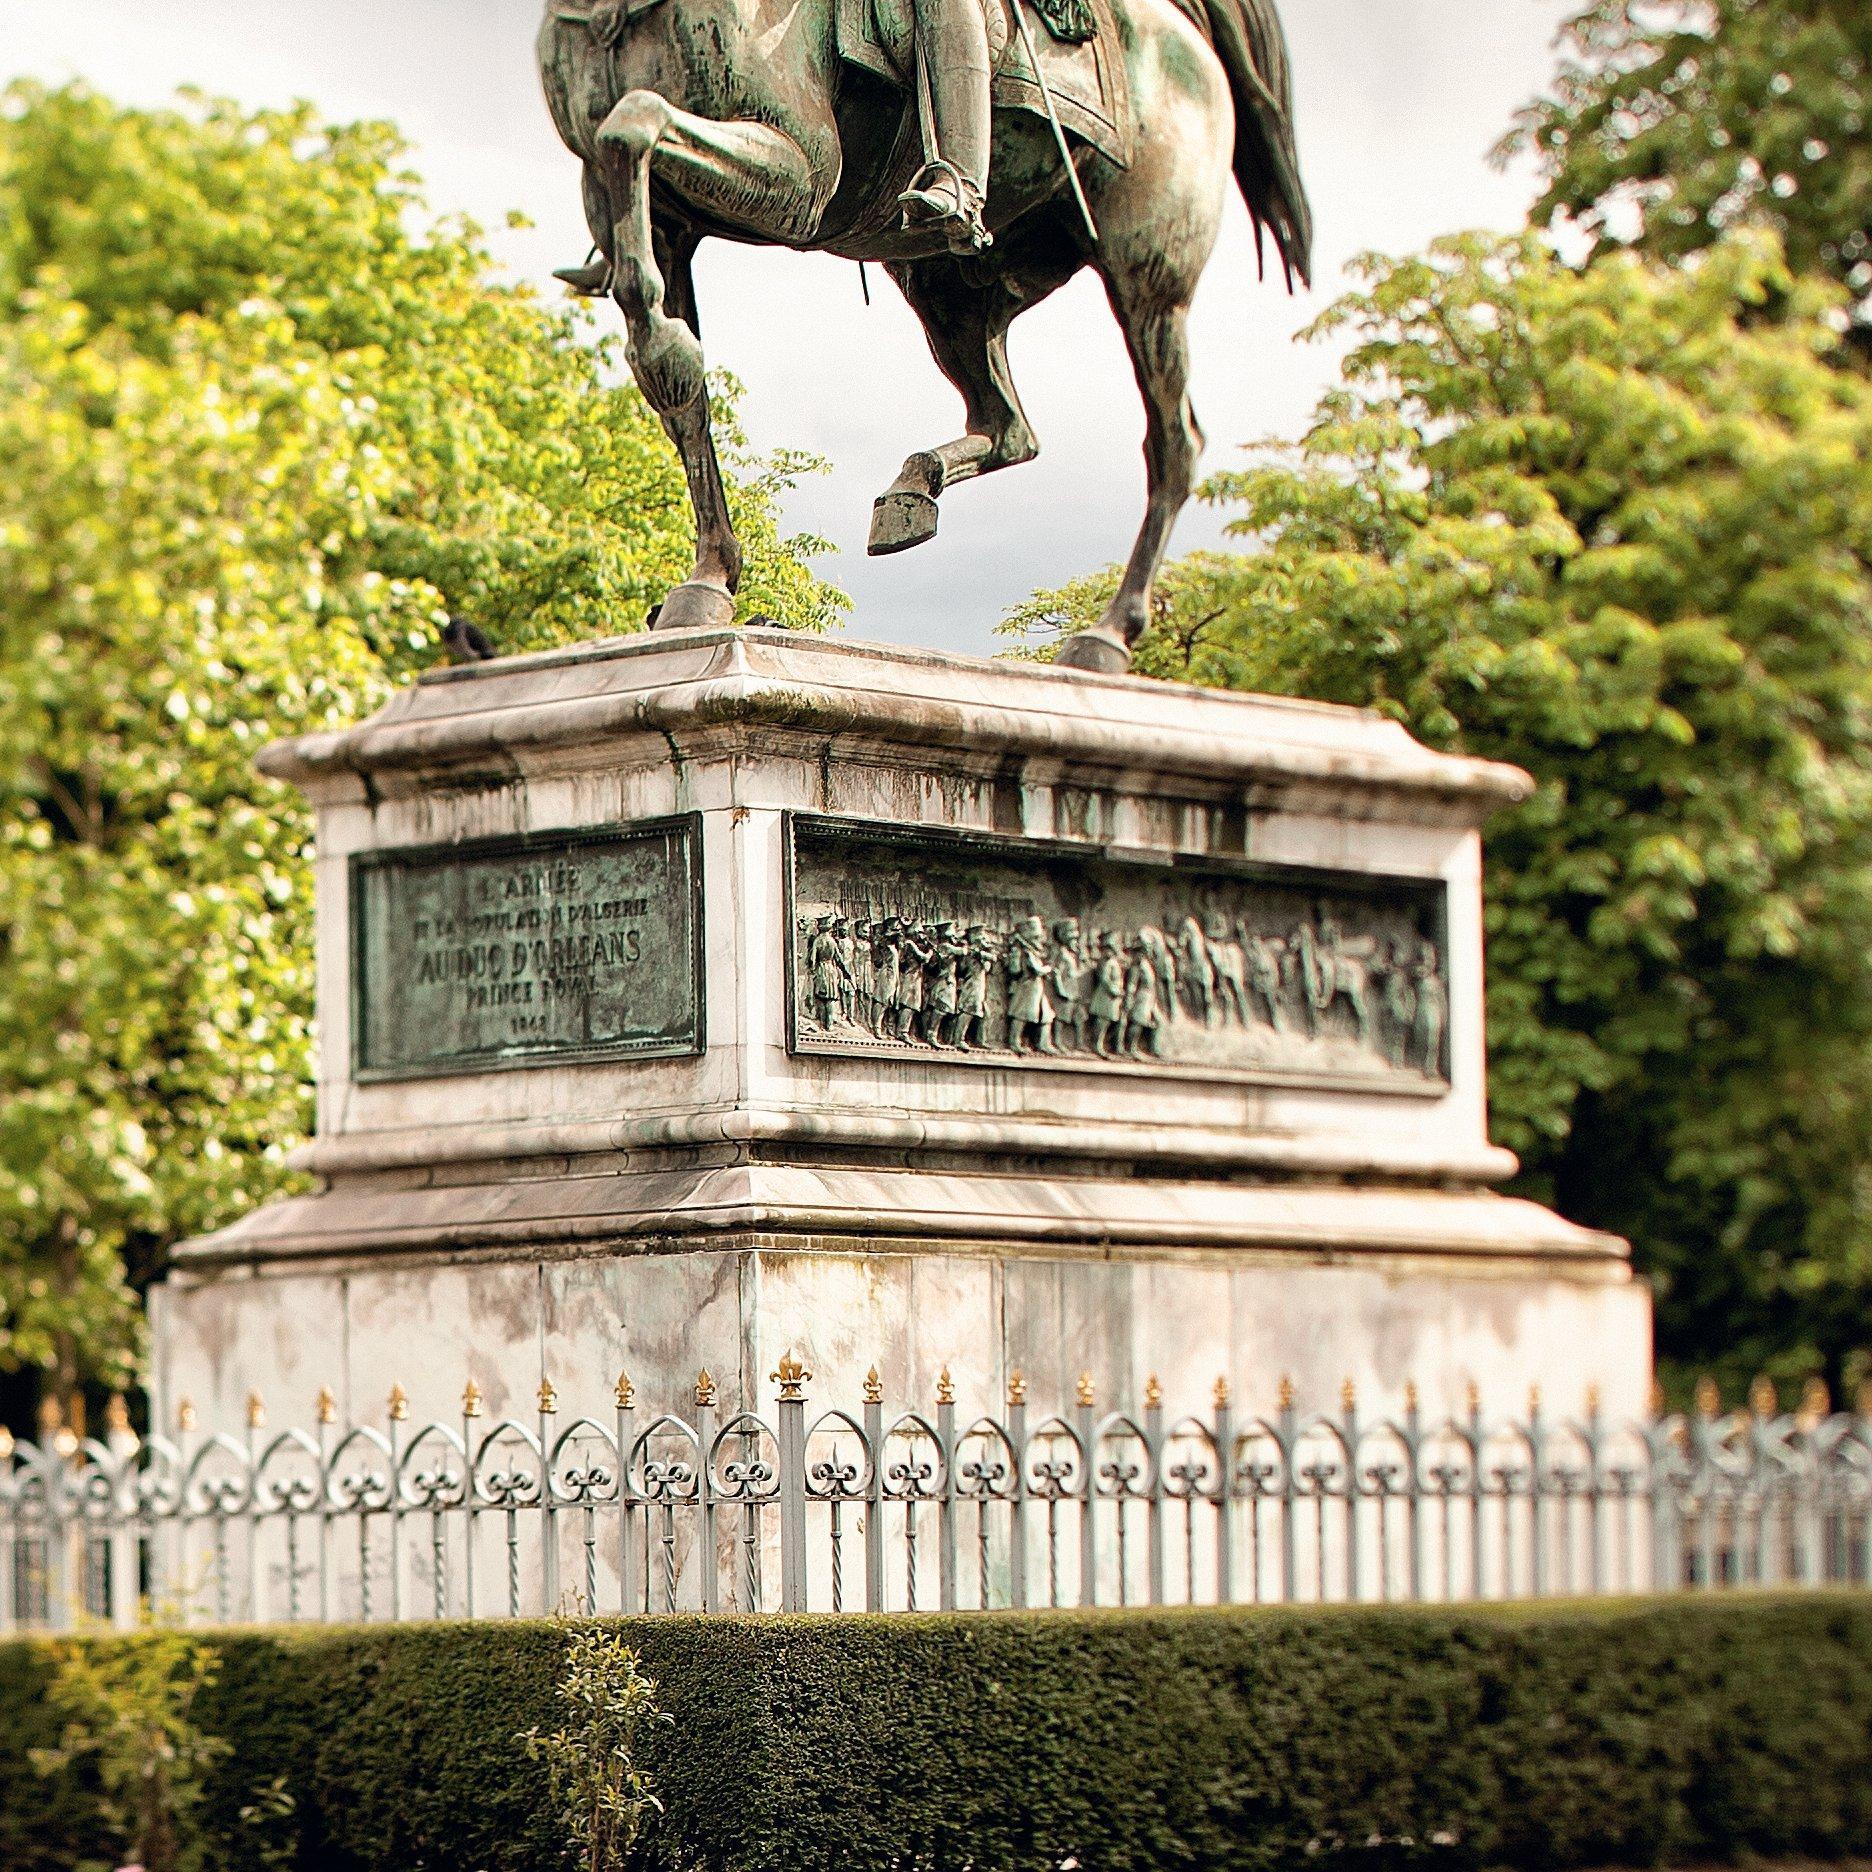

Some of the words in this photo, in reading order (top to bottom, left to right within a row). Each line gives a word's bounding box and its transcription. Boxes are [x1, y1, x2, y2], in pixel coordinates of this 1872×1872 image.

[417, 948, 449, 984] AU
[455, 943, 503, 981] DUC
[466, 980, 532, 1009] PRINCE
[540, 974, 600, 1003] ROYAL
